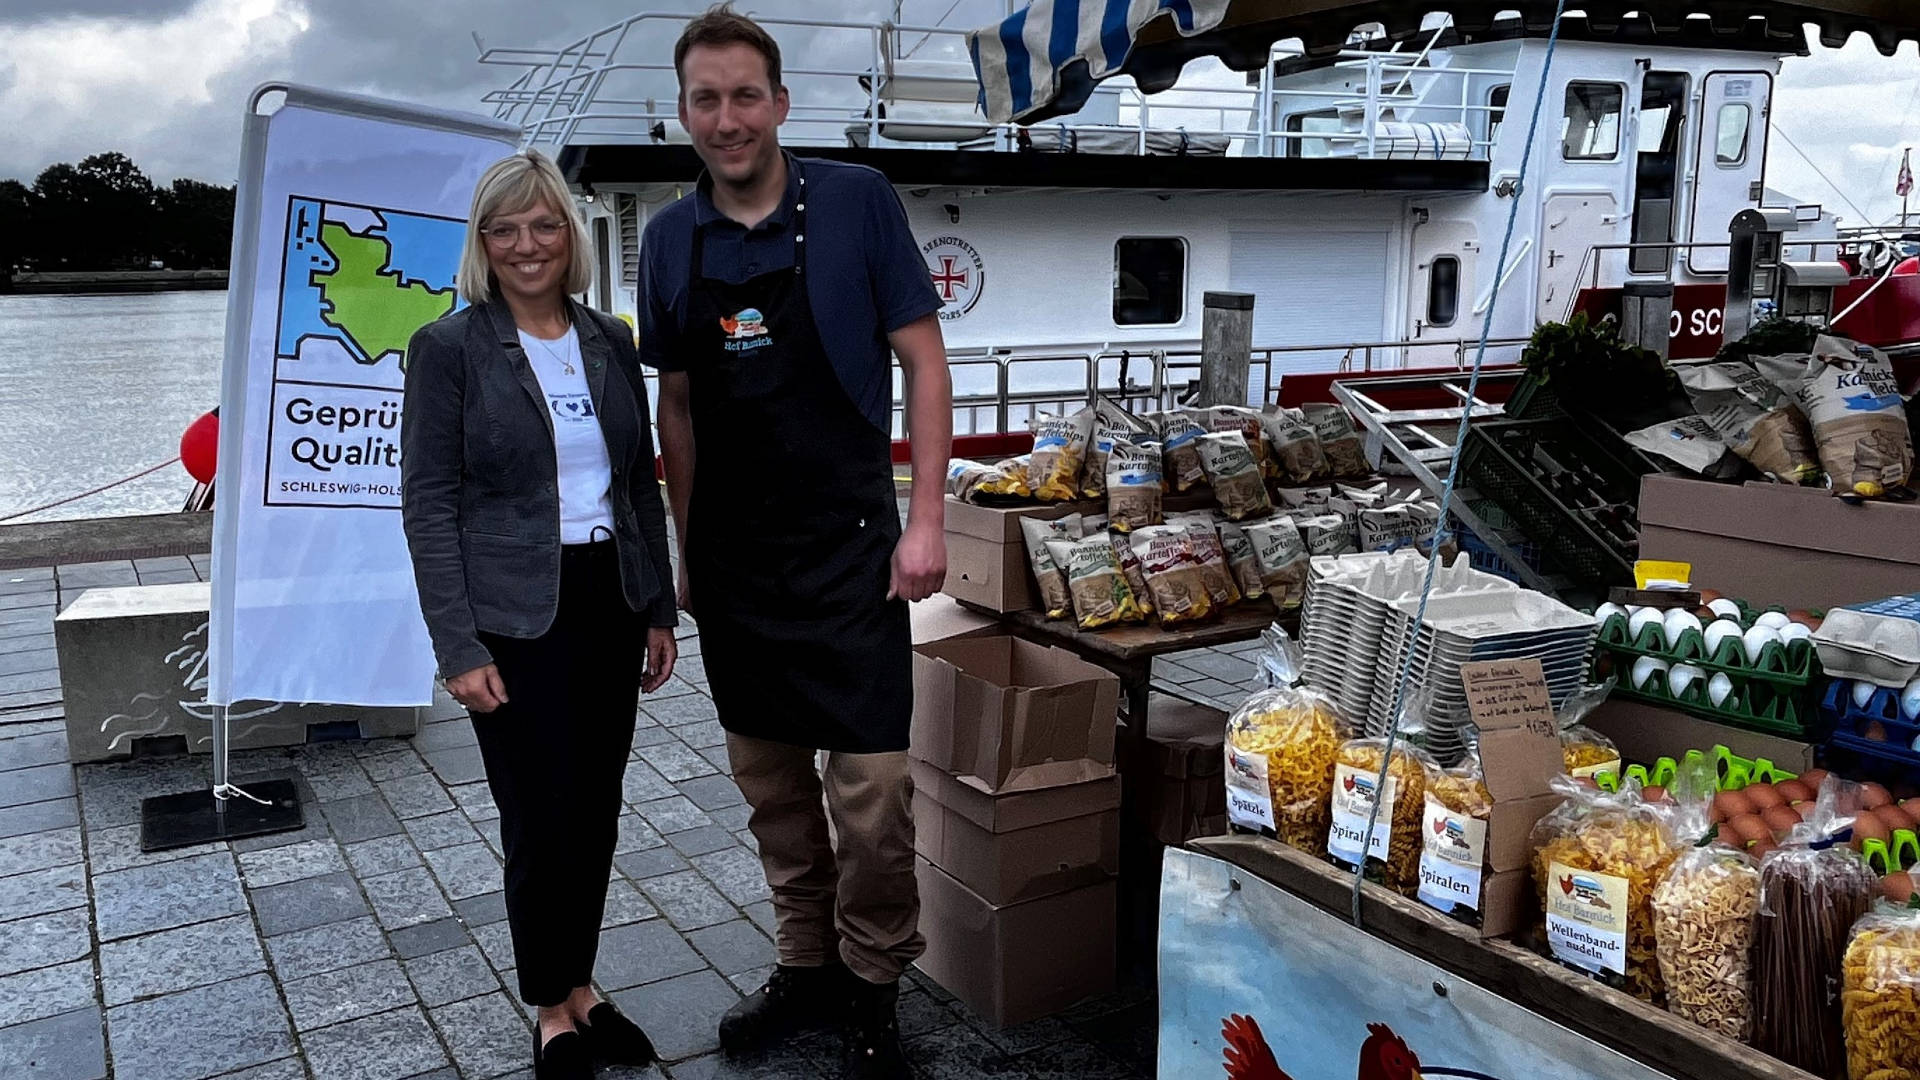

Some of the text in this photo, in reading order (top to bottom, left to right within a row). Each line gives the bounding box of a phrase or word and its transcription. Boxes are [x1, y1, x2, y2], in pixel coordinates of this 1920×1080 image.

[923, 237, 983, 271] SEENOTRETTER
[1690, 308, 1724, 336] SC
[286, 397, 402, 433] Geprü
[291, 436, 402, 472] Qualit
[281, 481, 402, 496] SCHLESWIG-HOLS
[1232, 795, 1265, 817] Spätzle
[1333, 822, 1381, 847] Spiraln
[1421, 865, 1471, 895] Spiralen
[1551, 921, 1620, 951] Wellenband-
[1566, 940, 1603, 959] nudeln
